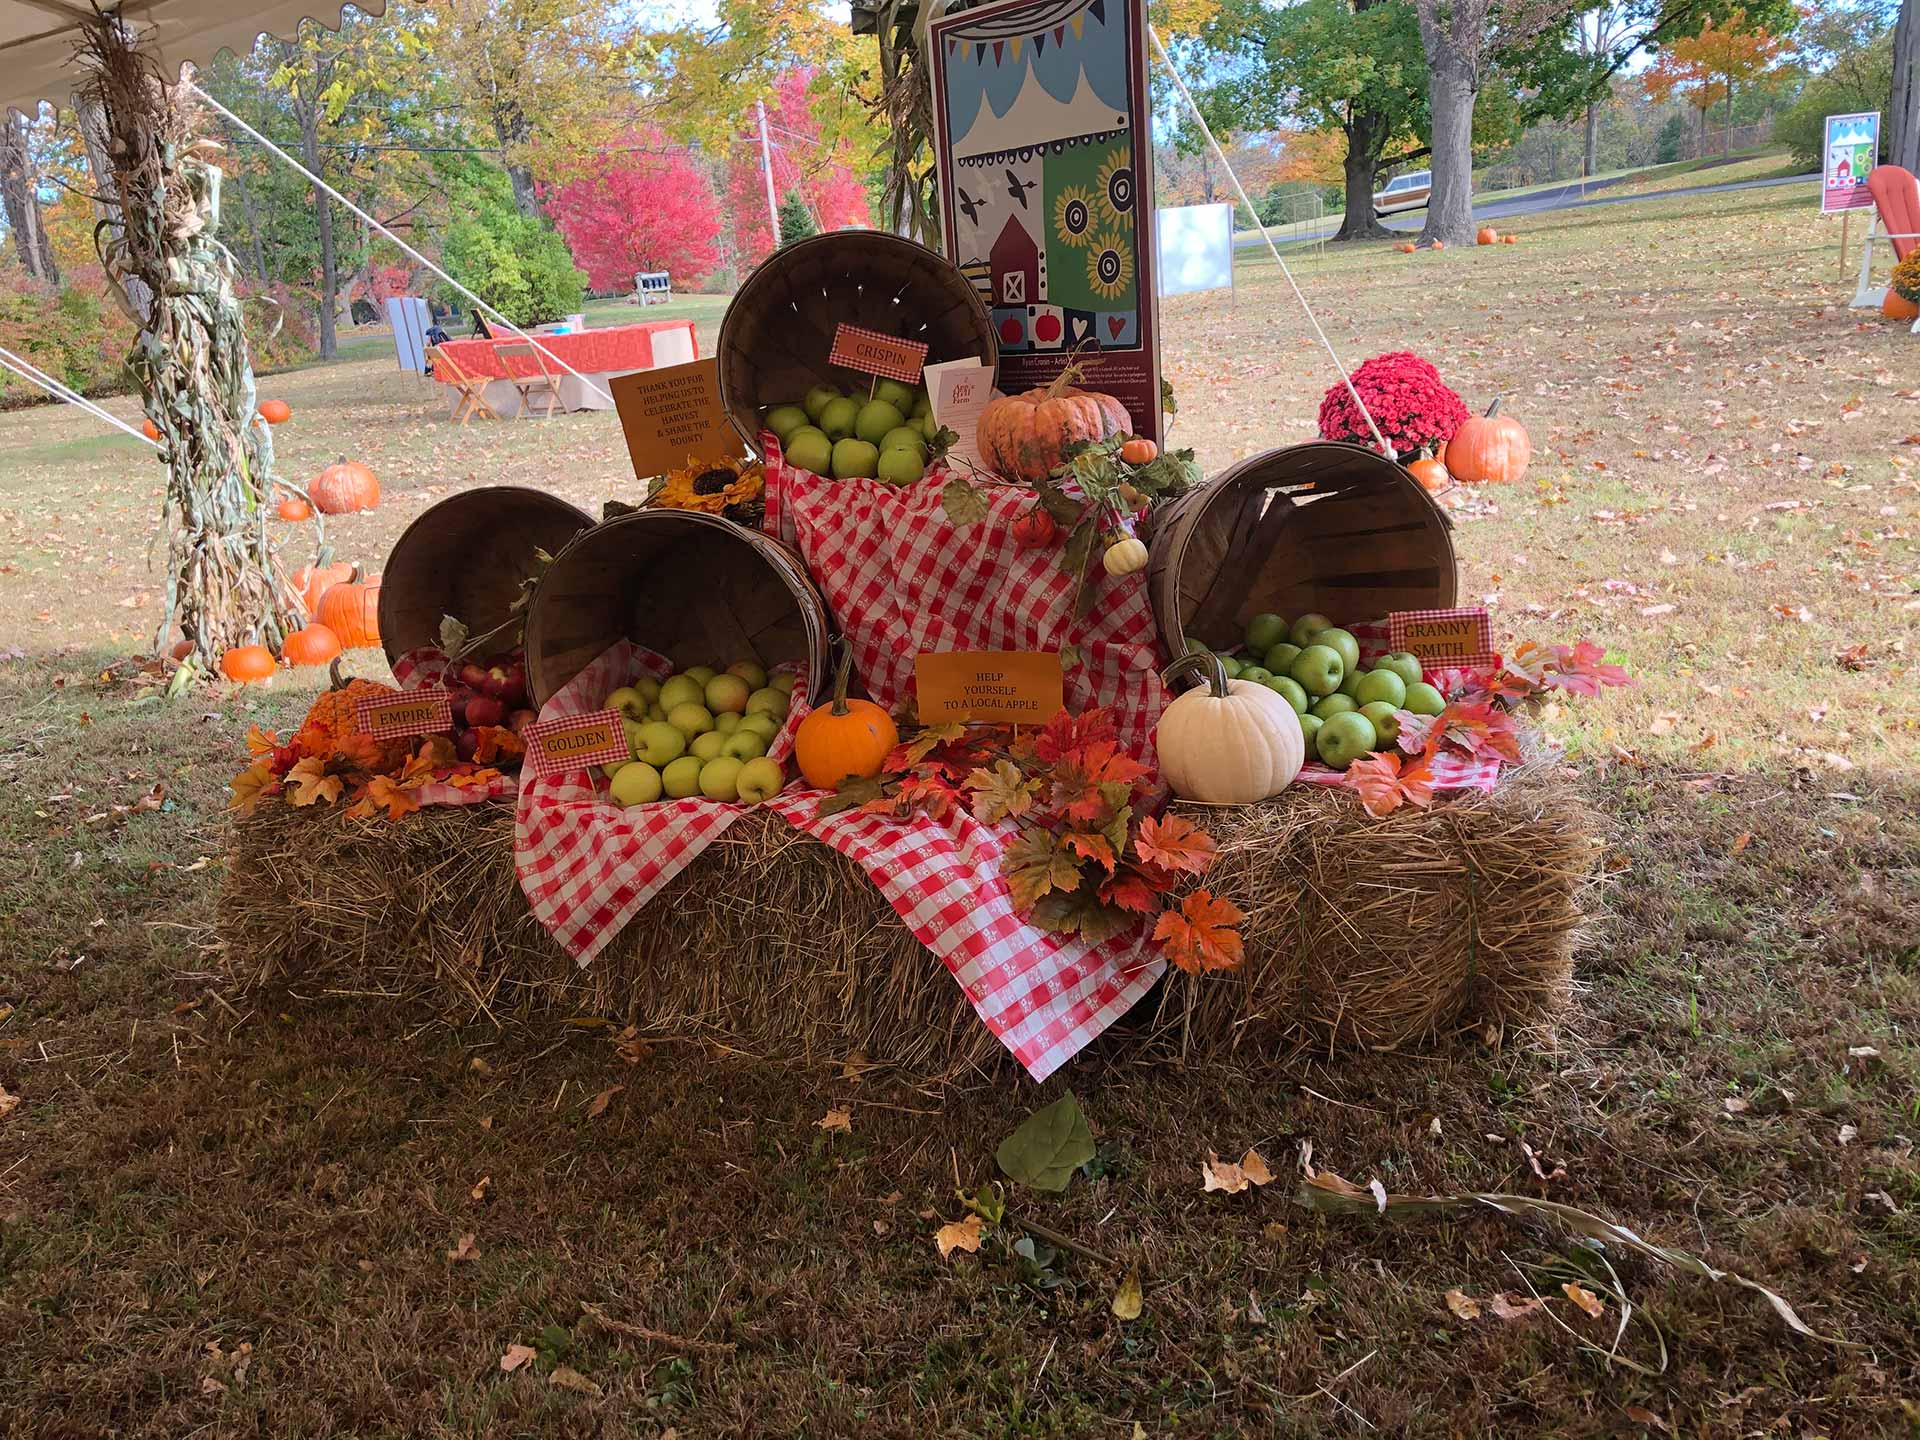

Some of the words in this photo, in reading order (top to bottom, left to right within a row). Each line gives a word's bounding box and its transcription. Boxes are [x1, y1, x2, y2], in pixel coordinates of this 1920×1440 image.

[856, 343, 907, 366] CRISPIN
[637, 381, 668, 394] THANK
[668, 377, 686, 388] YOU
[687, 374, 704, 384] FOR
[643, 390, 681, 405] HELPING
[681, 387, 692, 397] US
[692, 386, 705, 395] TO
[644, 400, 692, 417] CELEBRATE
[693, 396, 711, 408] THE
[661, 410, 699, 425] HARVEST
[657, 429, 664, 438] &
[665, 423, 693, 436] SHARE
[693, 420, 711, 431] THE
[670, 432, 704, 447] BOUNTY
[1404, 622, 1471, 638] GRANNY
[1413, 642, 1465, 657] SMITH
[976, 672, 1004, 682] HELP
[964, 685, 1017, 696] YOURSELF
[944, 700, 959, 710] TO
[961, 700, 969, 709] A
[970, 699, 1003, 709] LOCAL
[1005, 700, 1038, 711] APPLE
[380, 708, 434, 725] EMPIRE
[547, 730, 606, 753] GOLDEN
